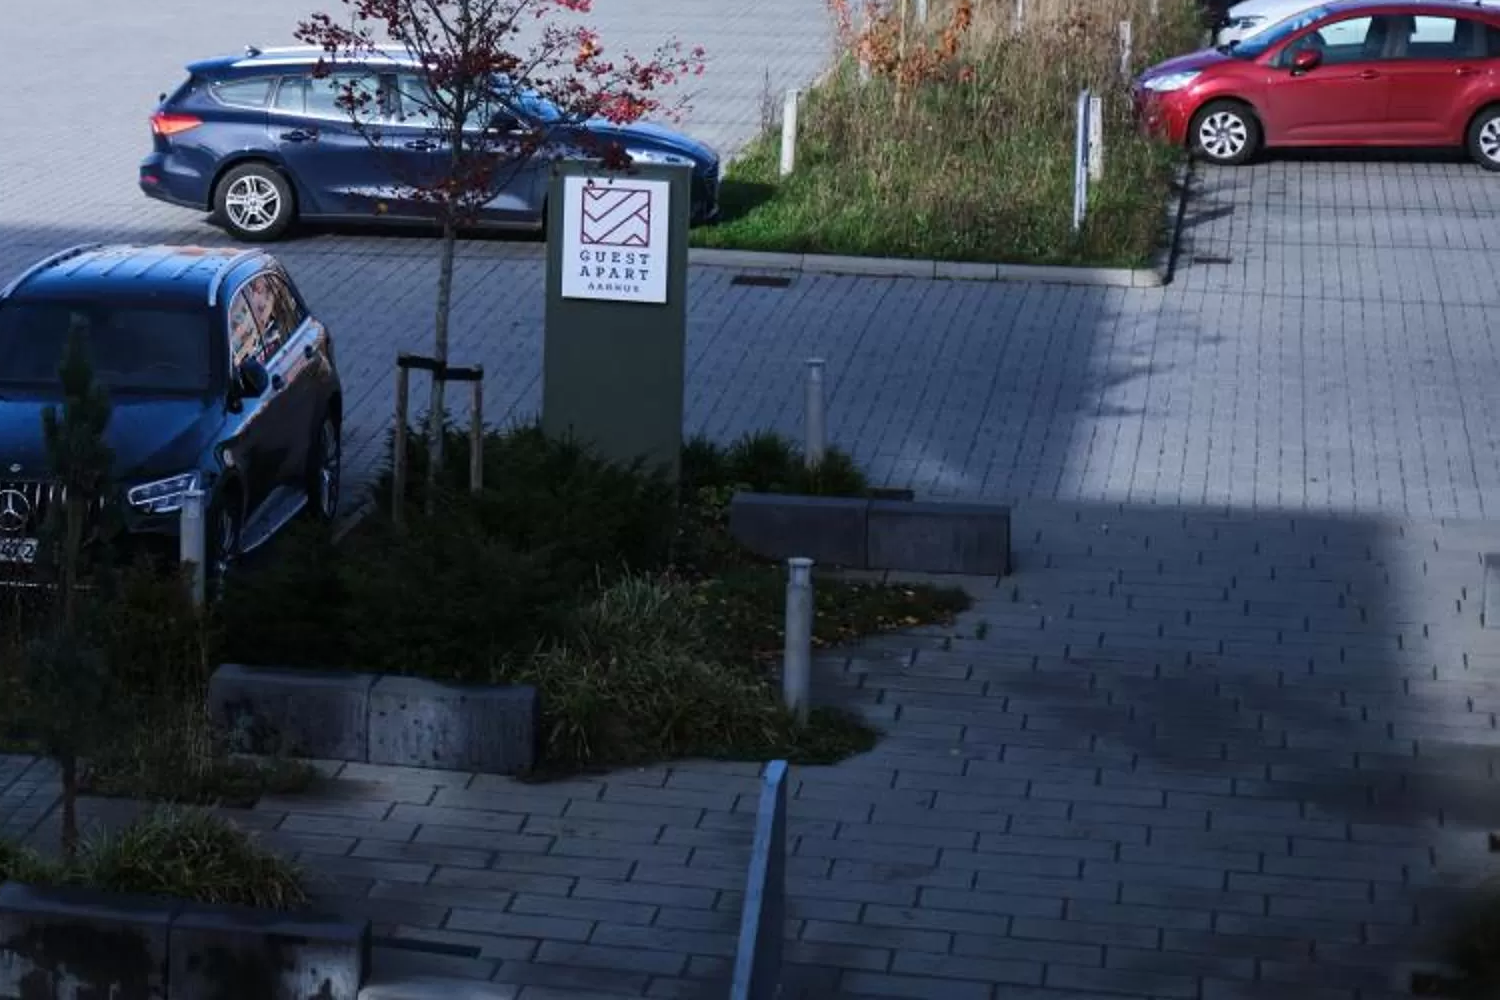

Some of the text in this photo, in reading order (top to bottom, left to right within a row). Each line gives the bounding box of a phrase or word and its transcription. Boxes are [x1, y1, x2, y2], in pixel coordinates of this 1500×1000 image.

[580, 250, 650, 265] GUEST
[580, 266, 648, 281] APART
[588, 282, 640, 293] AARHUS
